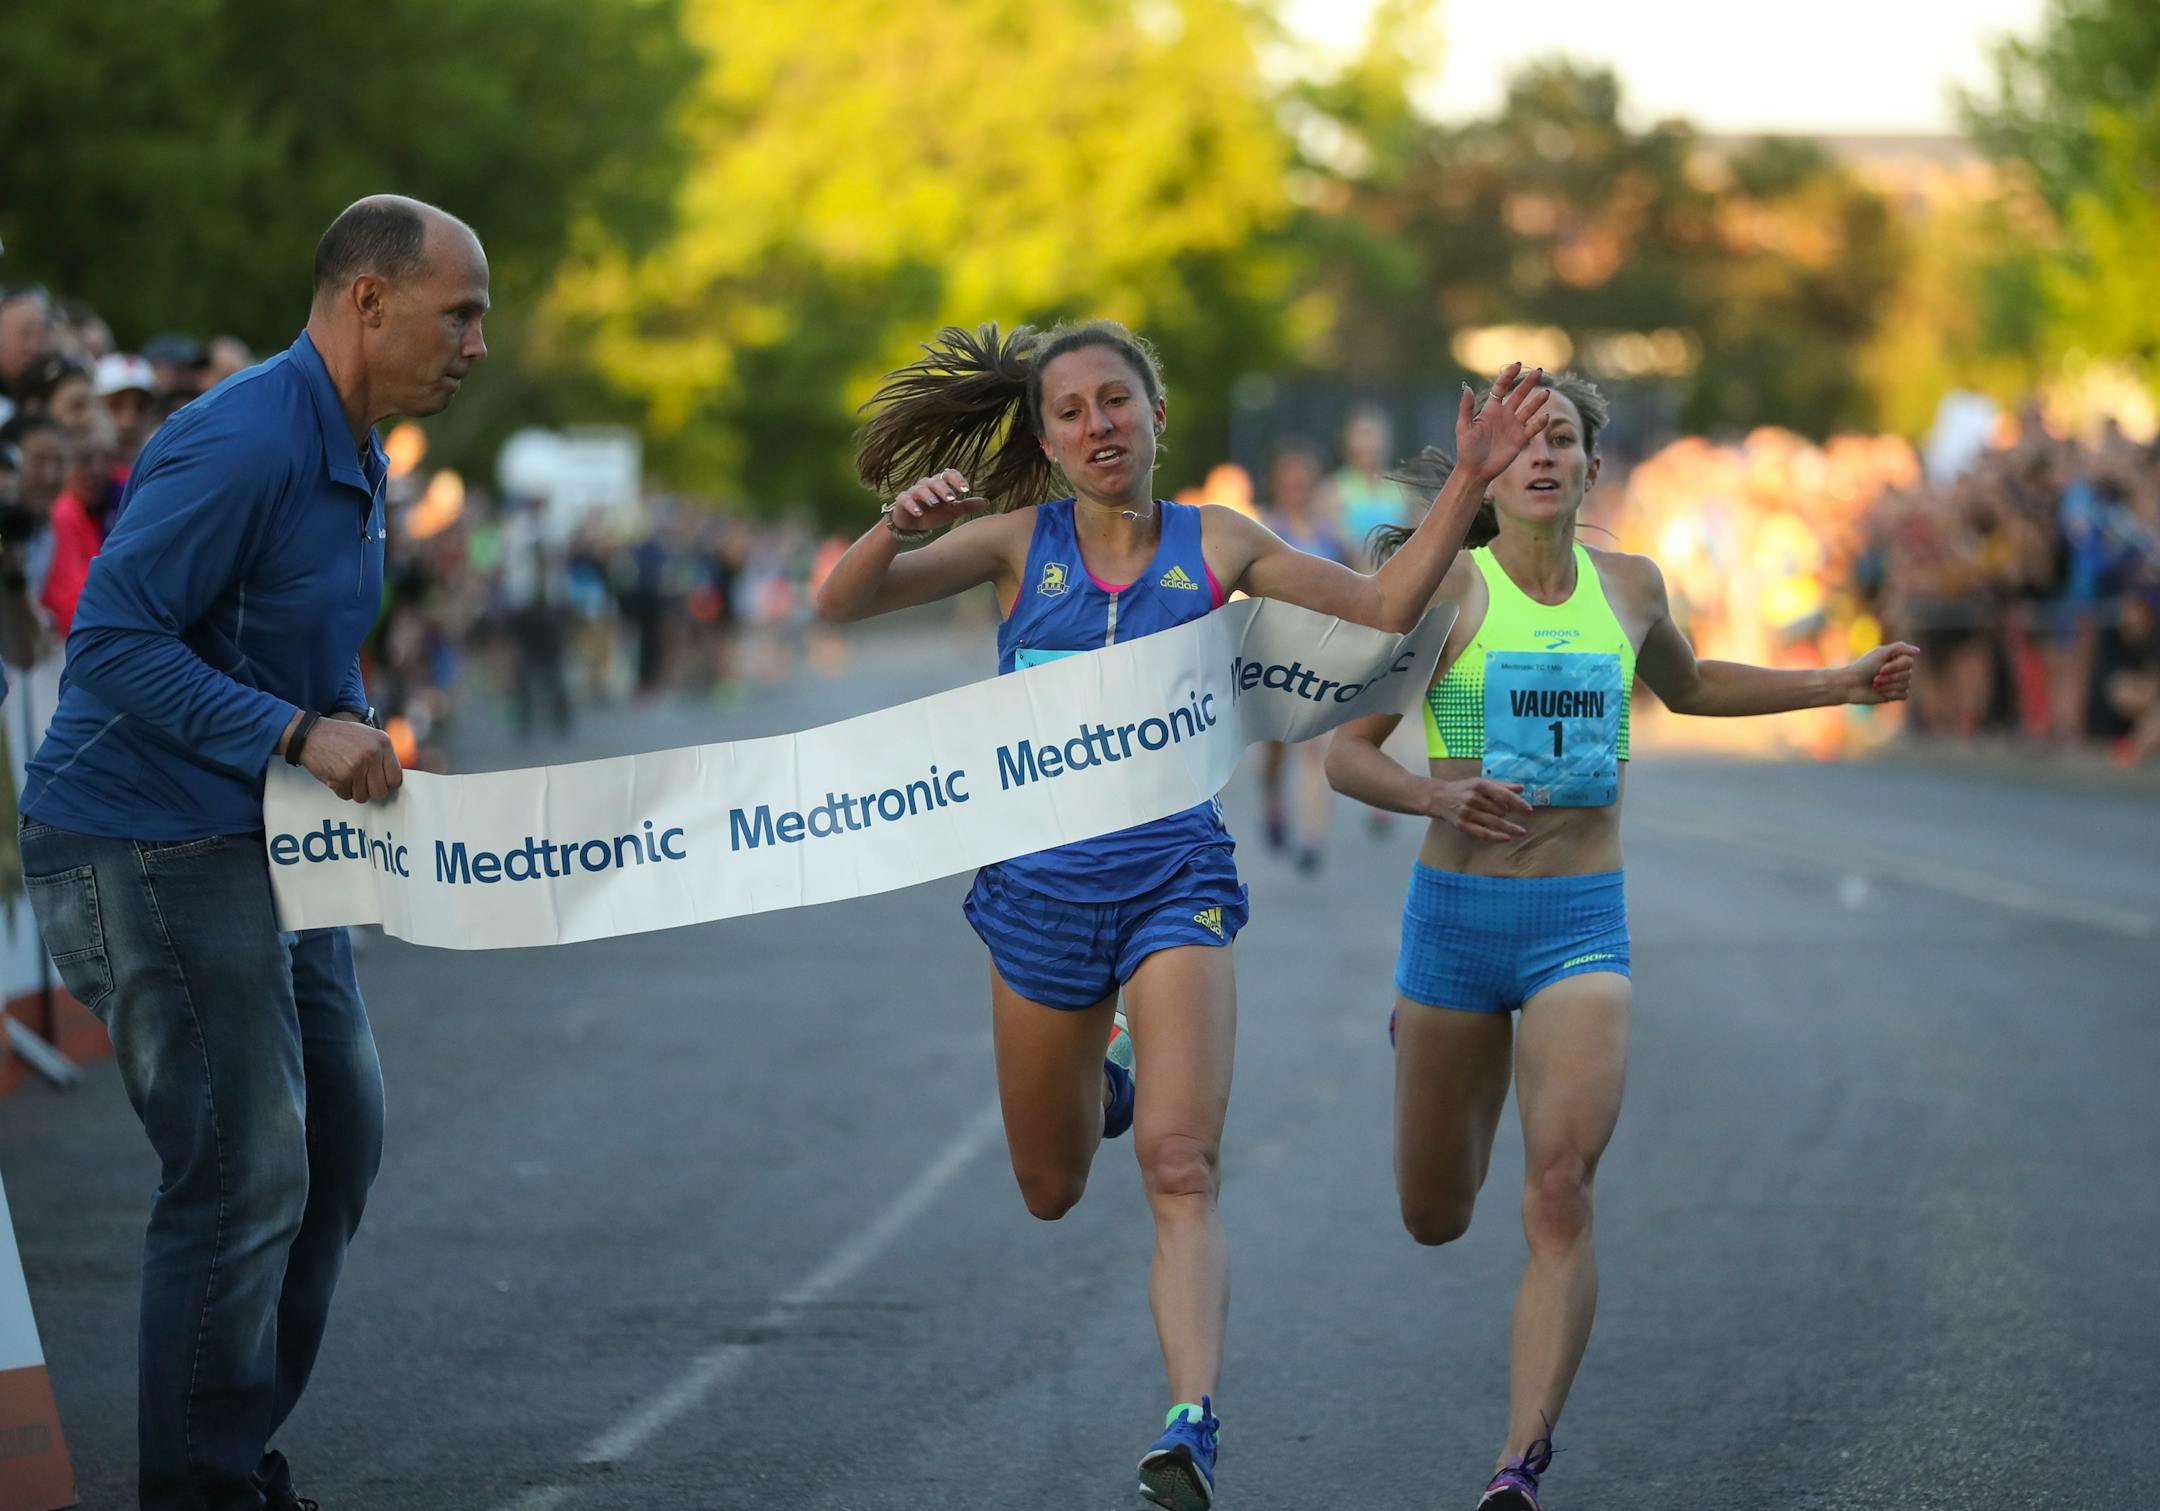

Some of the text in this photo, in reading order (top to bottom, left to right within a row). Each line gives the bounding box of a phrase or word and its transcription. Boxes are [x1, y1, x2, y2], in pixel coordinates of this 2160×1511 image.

[1160, 579, 1199, 590] adidas
[1510, 690, 1604, 718] VAUGHN
[1548, 721, 1563, 758] 1
[435, 820, 687, 885] Medtronic
[729, 765, 970, 851] Medtronic
[996, 690, 1217, 791] Medtronic
